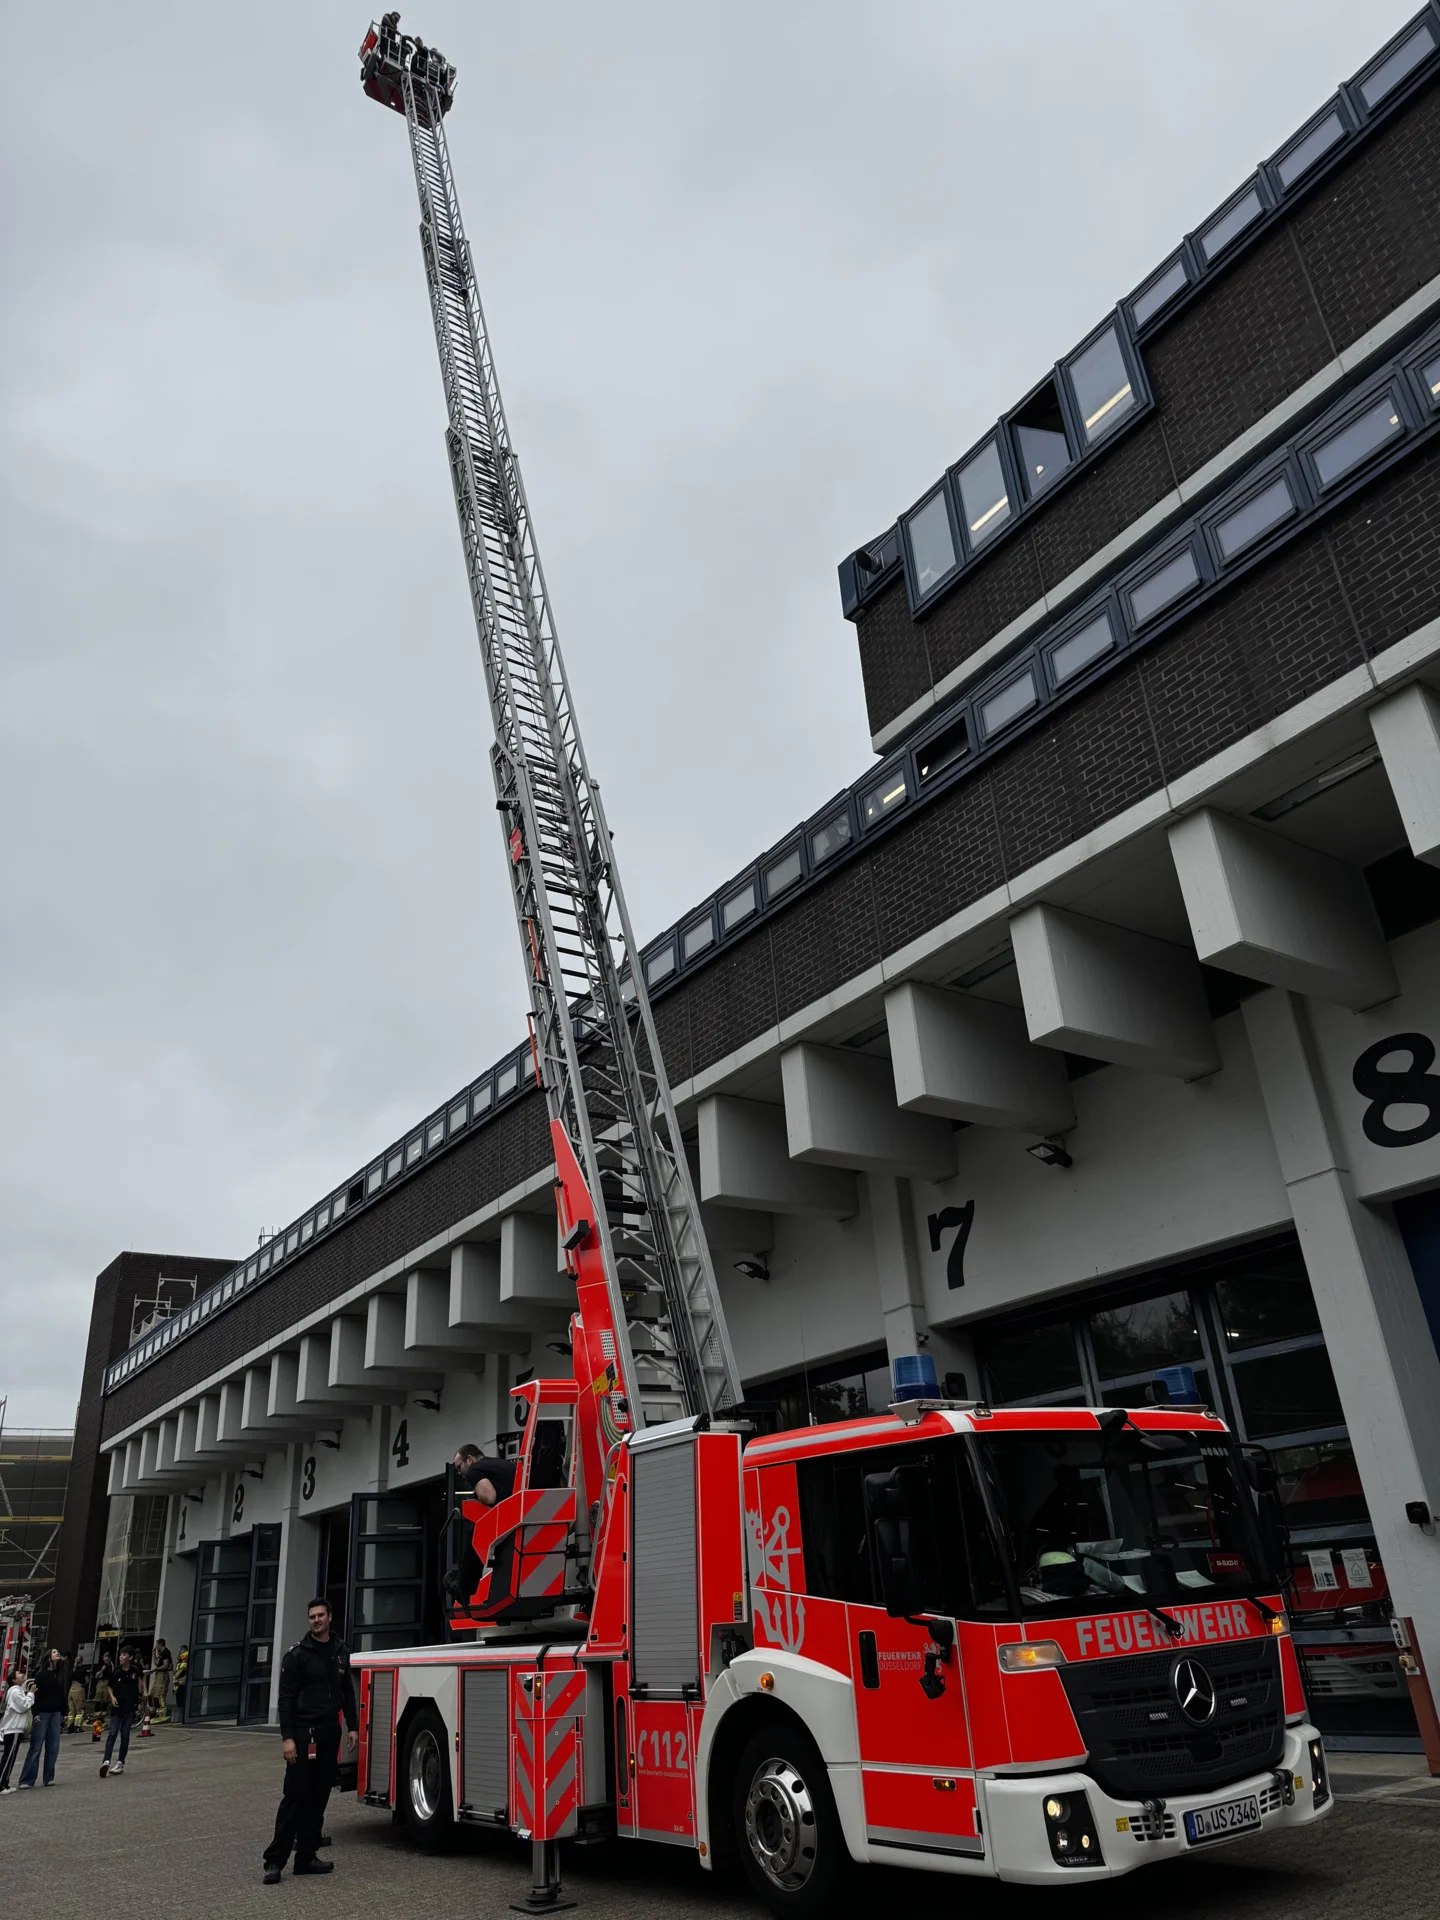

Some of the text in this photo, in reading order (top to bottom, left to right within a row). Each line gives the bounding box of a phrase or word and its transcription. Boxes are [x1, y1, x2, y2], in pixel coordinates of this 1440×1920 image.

[1353, 1032, 1440, 1148] 8
[927, 1199, 975, 1290] 7
[392, 1419, 410, 1468] 4
[302, 1456, 316, 1501] 3
[179, 1505, 188, 1541] 1
[232, 1483, 245, 1523] 2
[1075, 1603, 1251, 1657] FEUERWEHR
[878, 1651, 922, 1661] FEUERWEHR
[650, 1729, 689, 1770] 112
[1227, 1800, 1257, 1827] 2346
